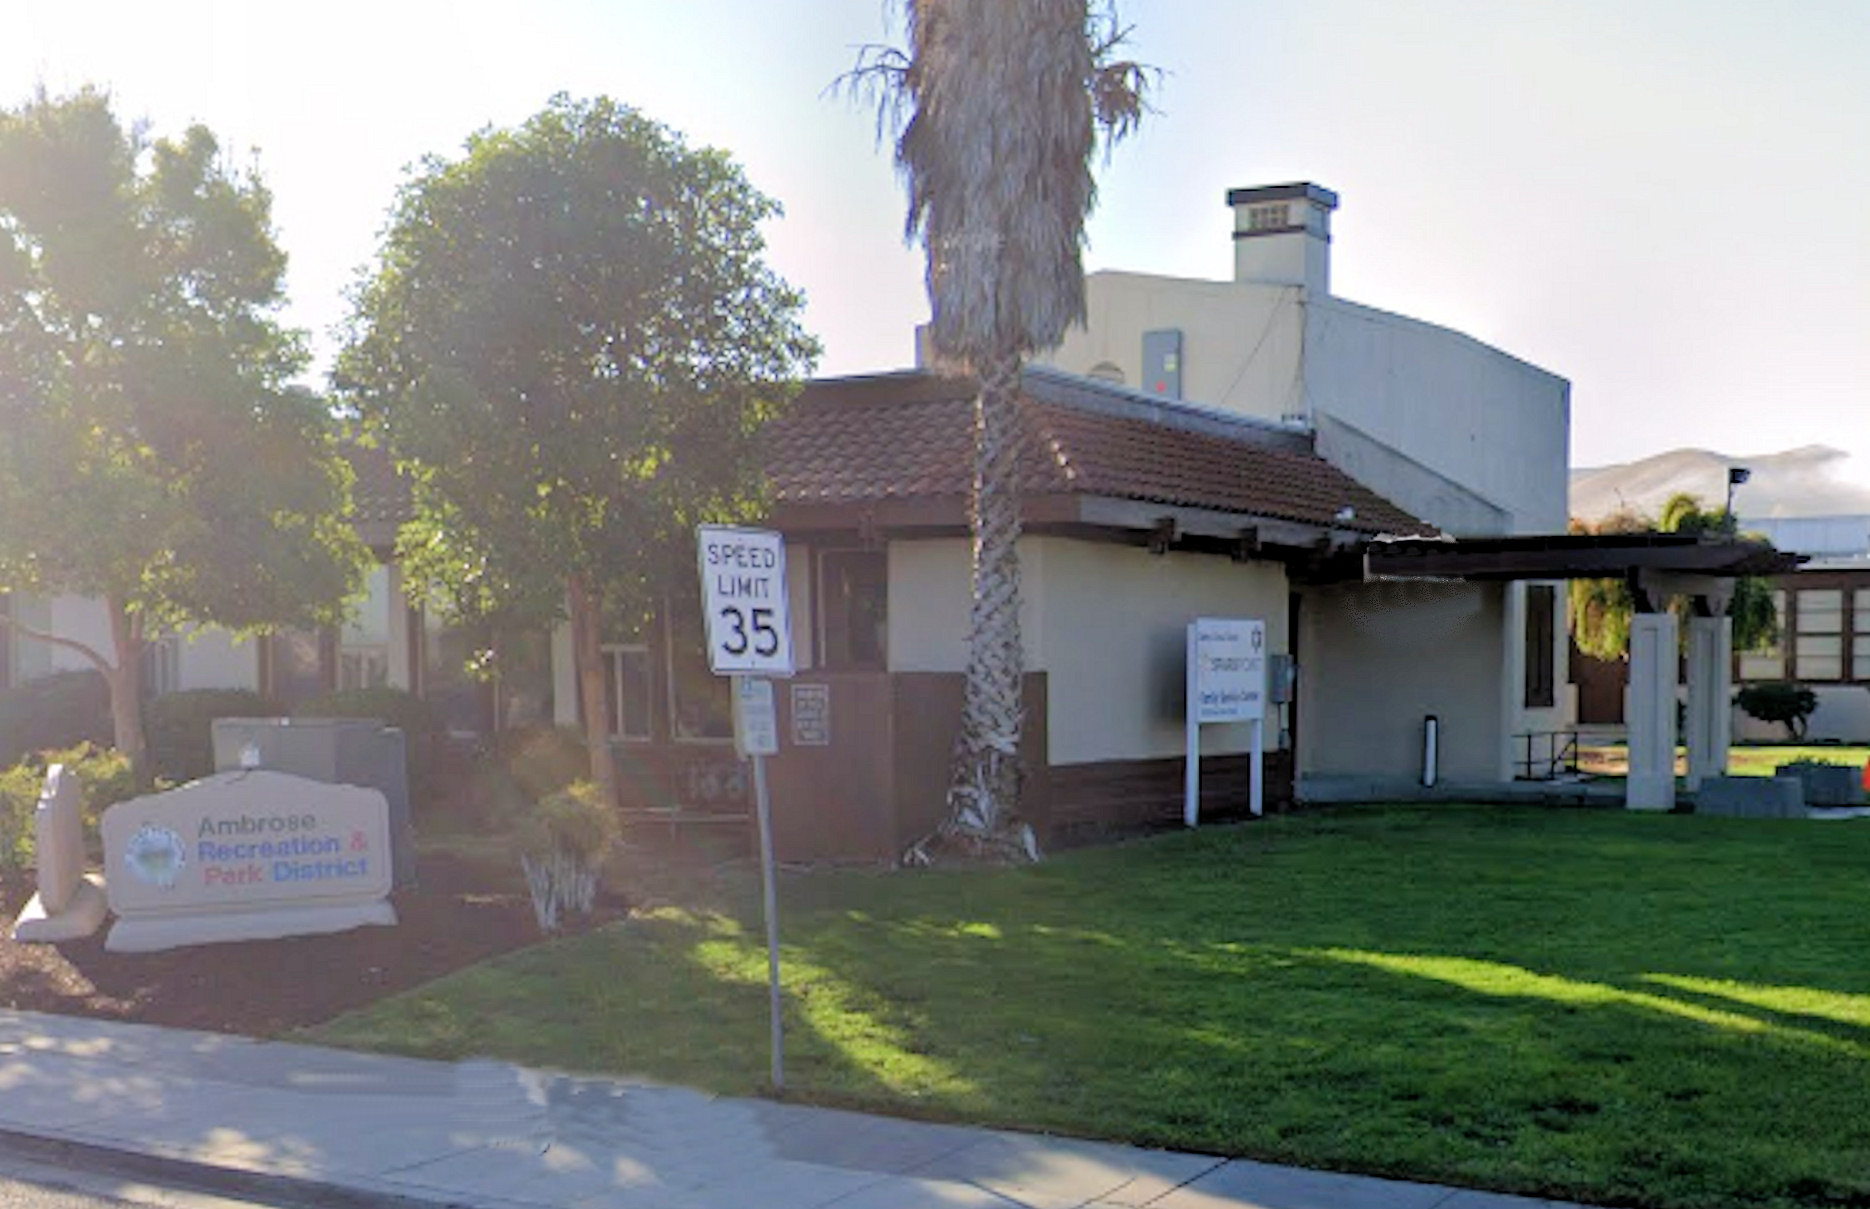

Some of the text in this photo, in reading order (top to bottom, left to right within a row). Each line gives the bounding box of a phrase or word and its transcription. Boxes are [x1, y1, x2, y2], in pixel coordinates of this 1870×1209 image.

[707, 543, 775, 569] SPEED
[717, 574, 769, 598] LIMIT
[720, 606, 779, 658] 35
[199, 814, 317, 836] Ambrose
[198, 830, 368, 862] Recreation &
[204, 858, 369, 885] Park District
